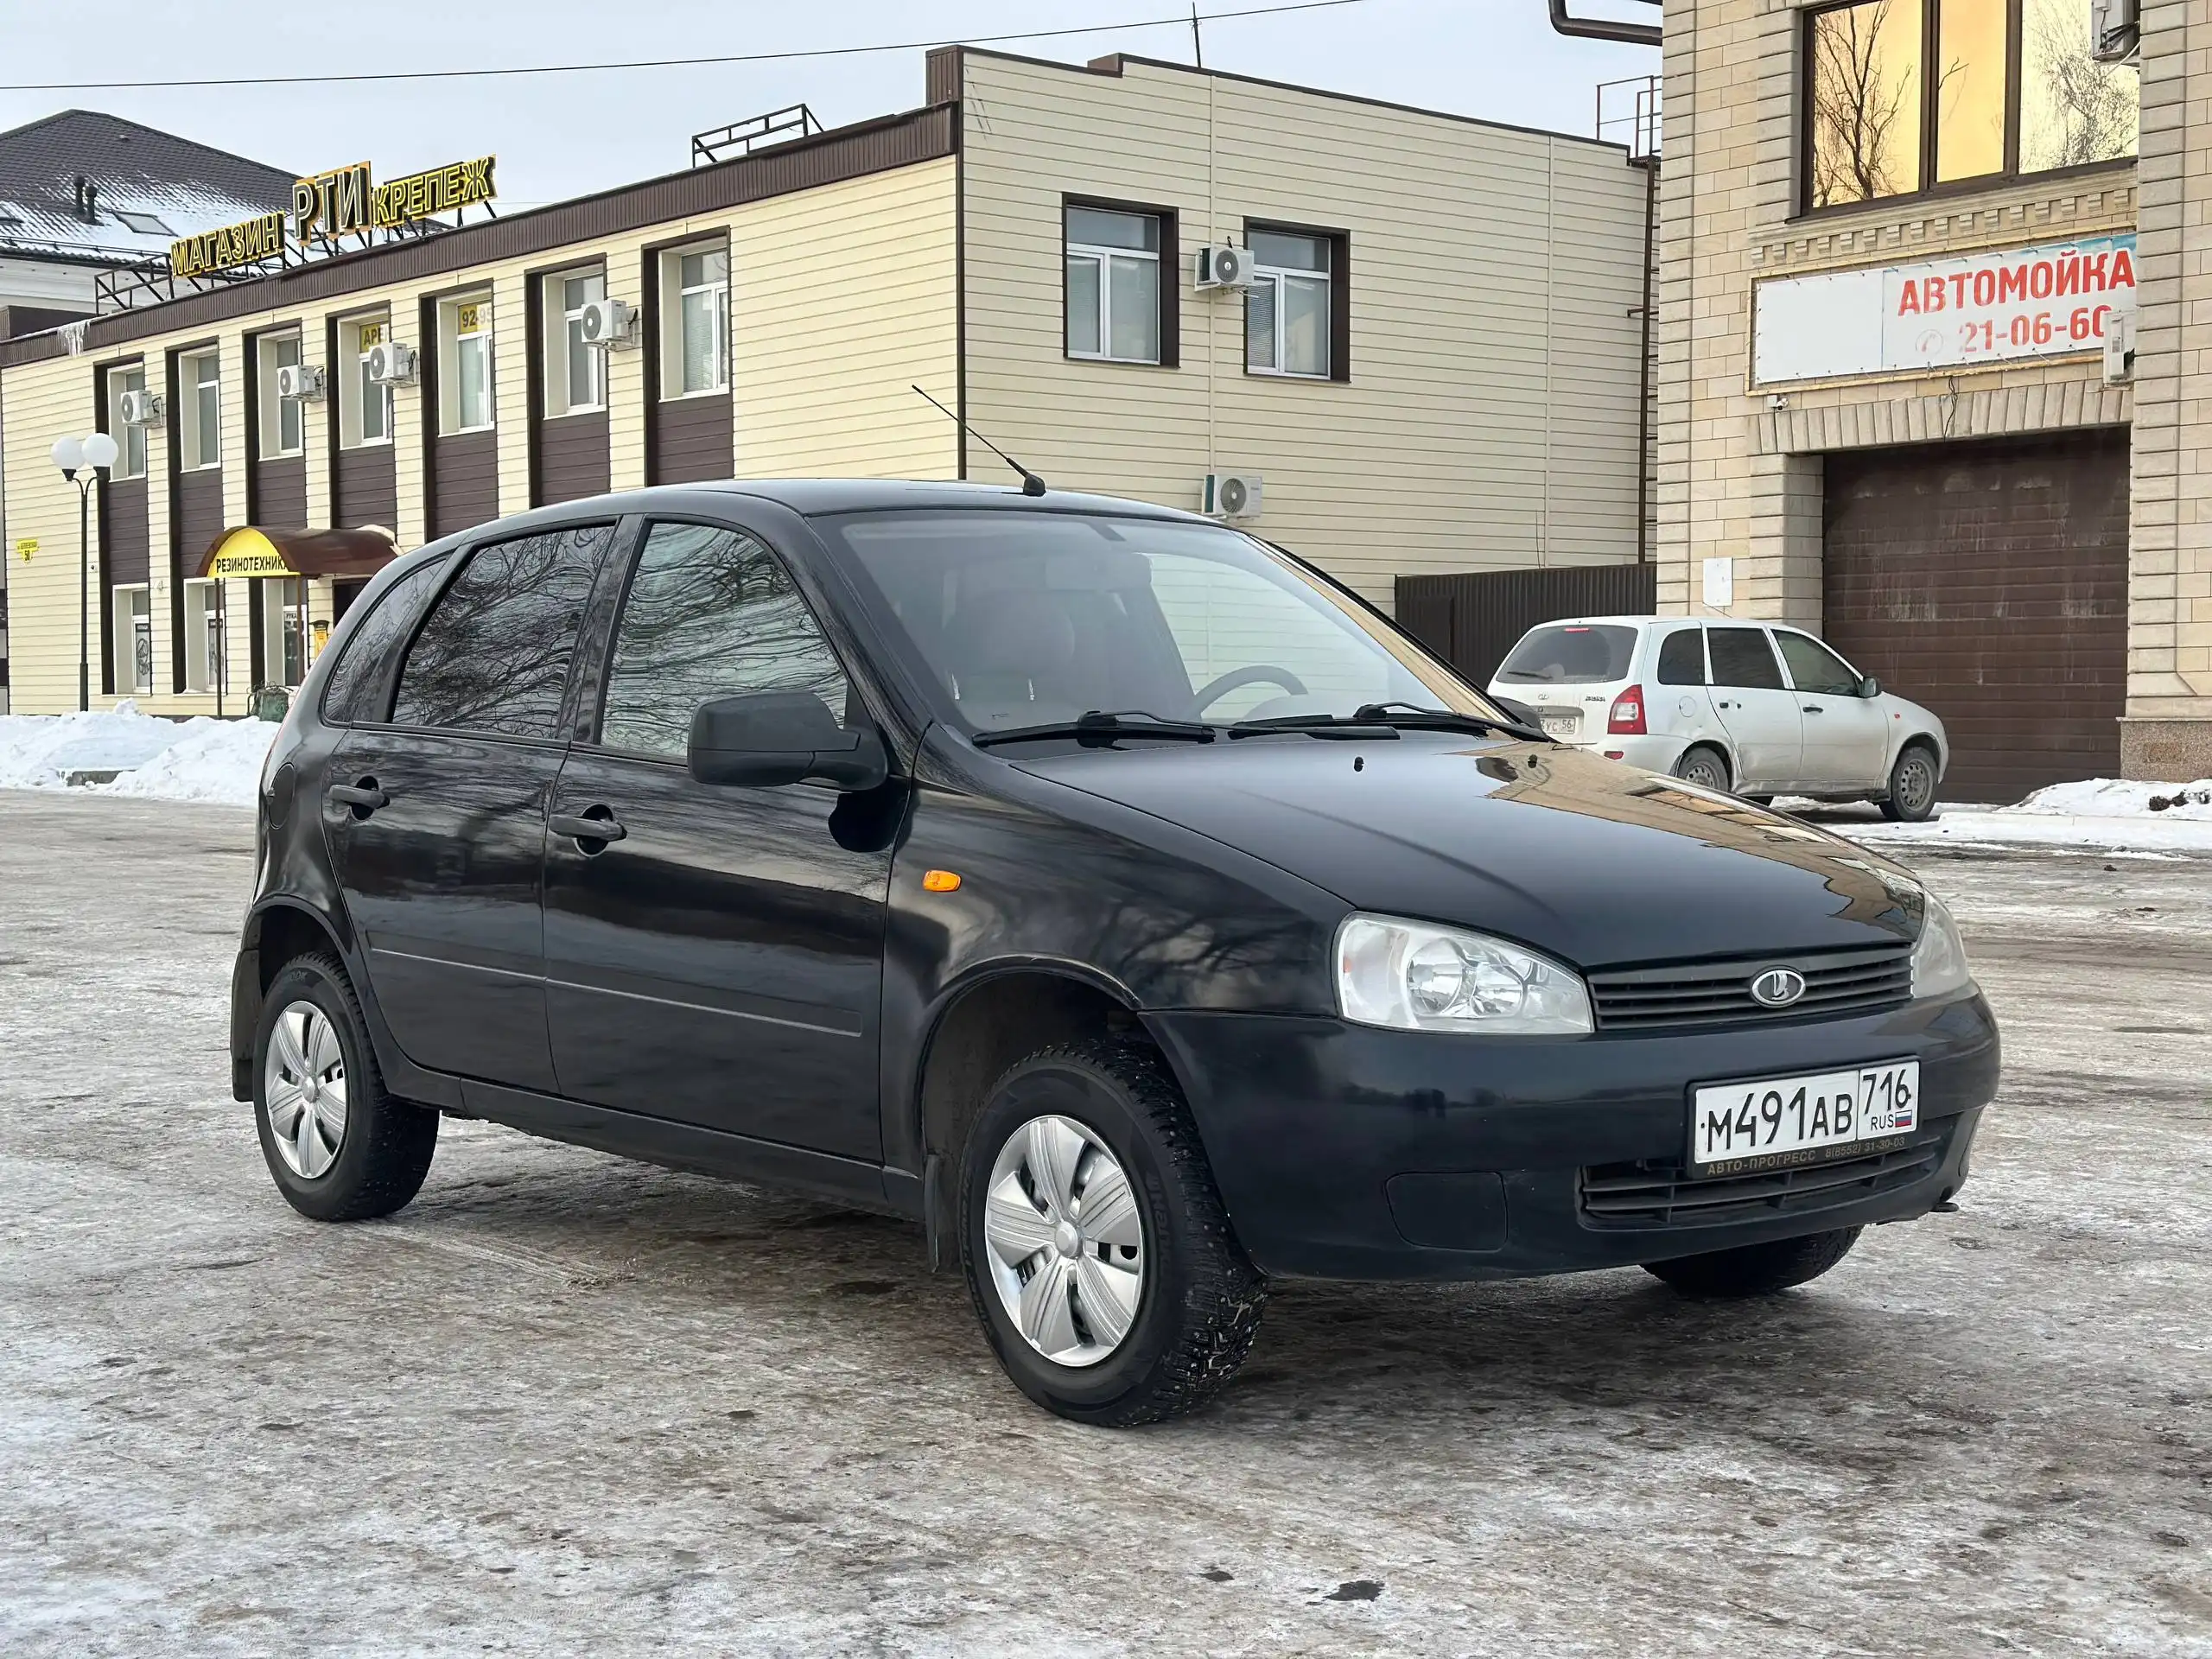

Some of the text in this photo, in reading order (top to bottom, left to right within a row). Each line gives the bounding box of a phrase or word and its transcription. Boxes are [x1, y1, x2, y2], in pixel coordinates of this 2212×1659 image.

[171, 154, 496, 276] МАГАЗИН РТИ КРЕПЕЖ
[1897, 250, 2135, 316] АВТОМОЙКА
[1707, 1069, 1910, 1153] М491АВ 716
[1871, 1114, 1894, 1131] RUS
[1707, 1149, 1815, 1176] АВТО-ПРОГРЕСС
